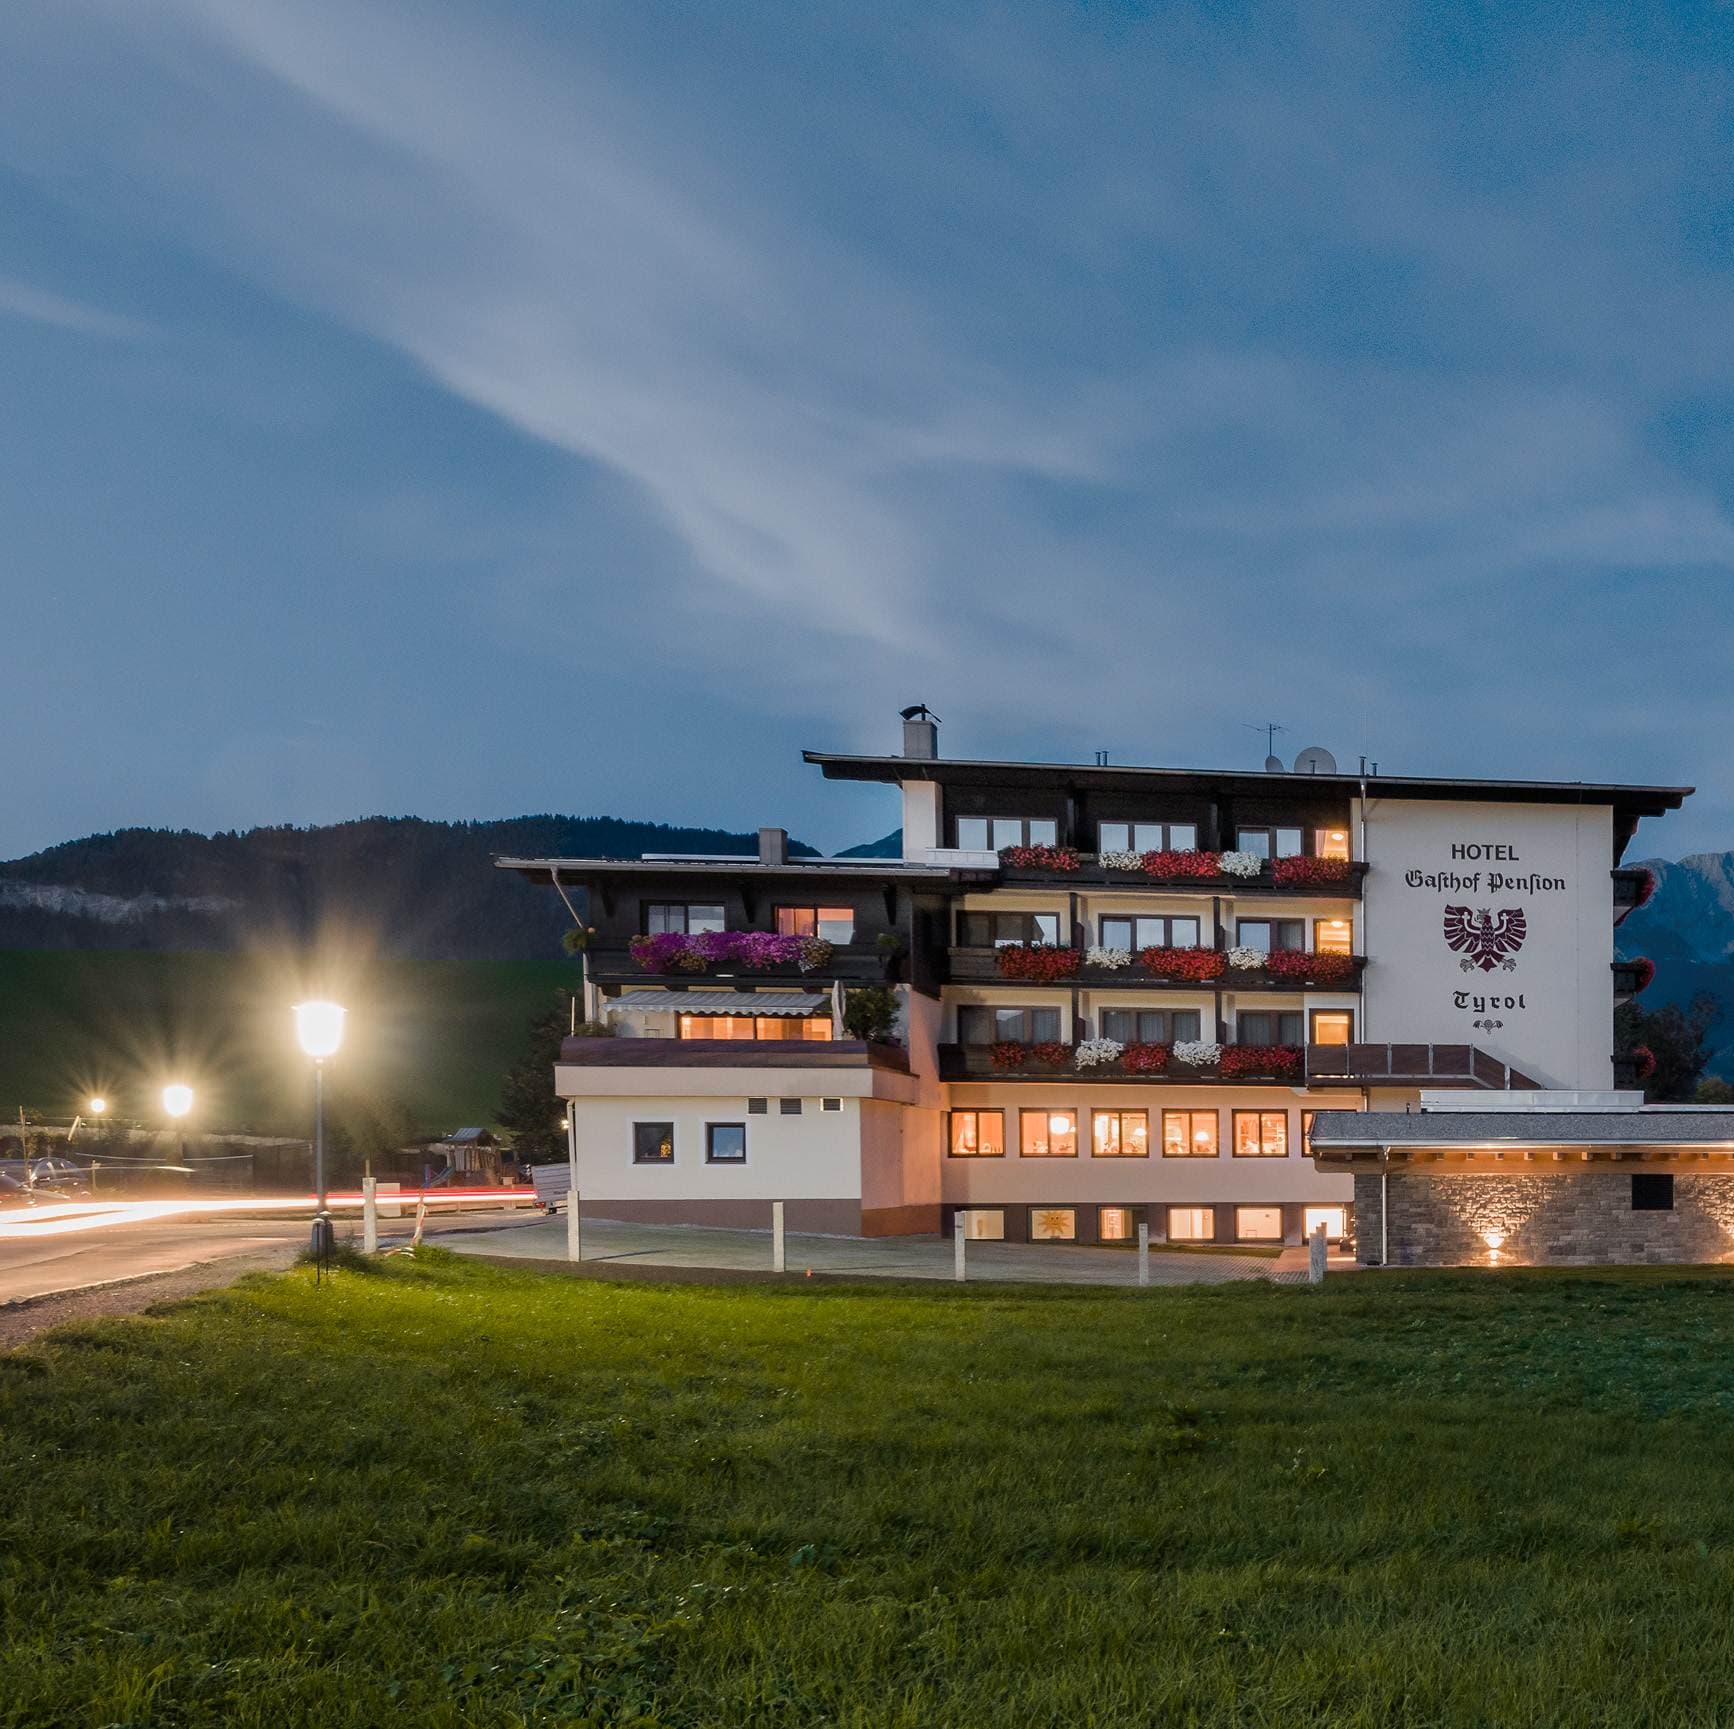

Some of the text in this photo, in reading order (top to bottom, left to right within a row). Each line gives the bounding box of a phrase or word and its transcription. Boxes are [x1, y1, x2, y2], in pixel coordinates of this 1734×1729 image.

[1451, 843, 1520, 861] HOTEL
[1404, 869, 1566, 896] Gasthof Pension
[1452, 990, 1526, 1013] Tyrol
